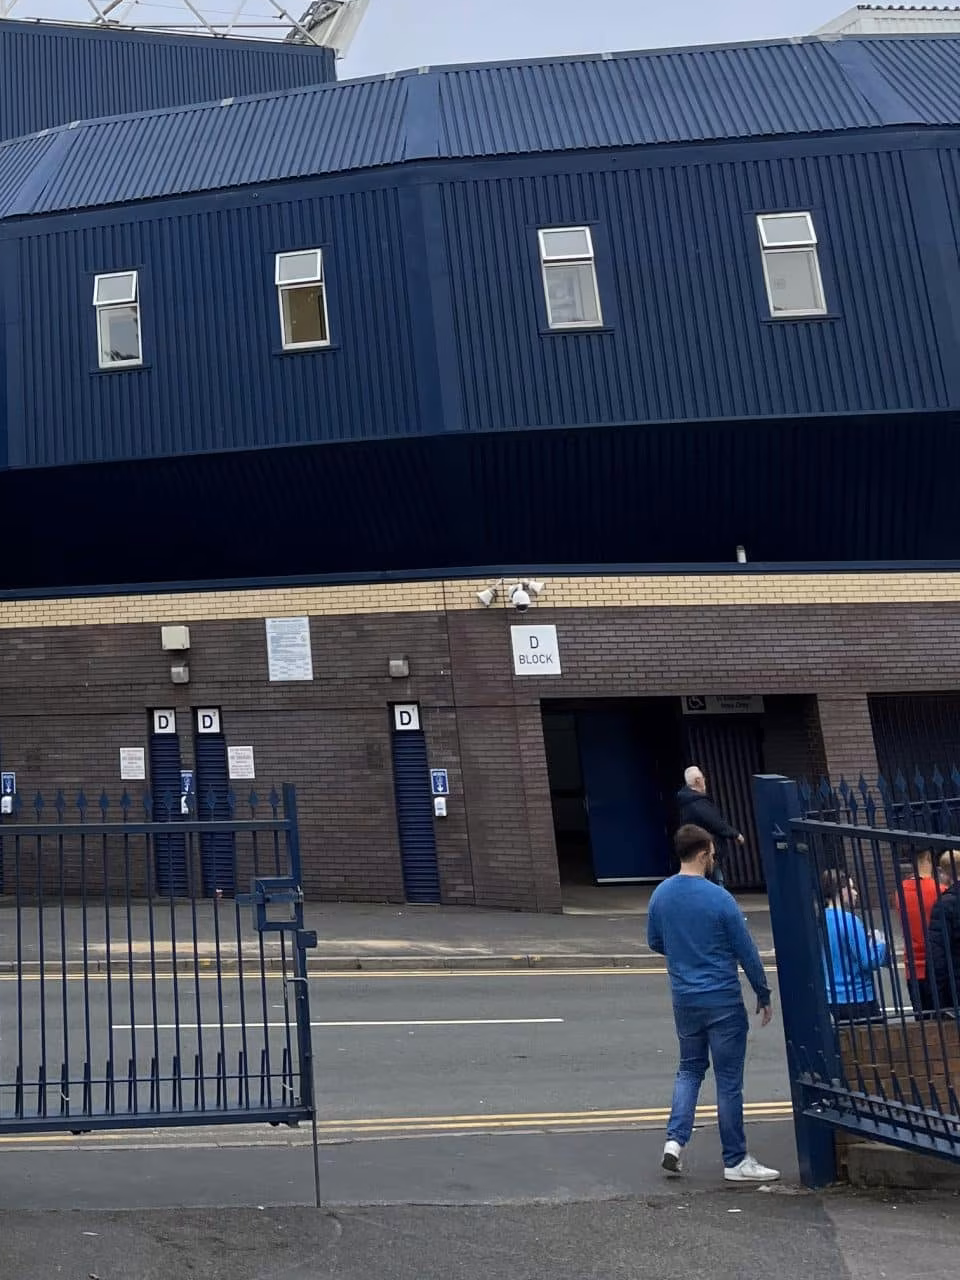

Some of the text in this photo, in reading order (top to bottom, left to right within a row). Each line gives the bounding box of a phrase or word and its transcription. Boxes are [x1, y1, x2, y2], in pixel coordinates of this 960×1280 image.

[529, 635, 539, 649] D
[518, 654, 553, 665] BLOCK
[400, 710, 412, 726] D
